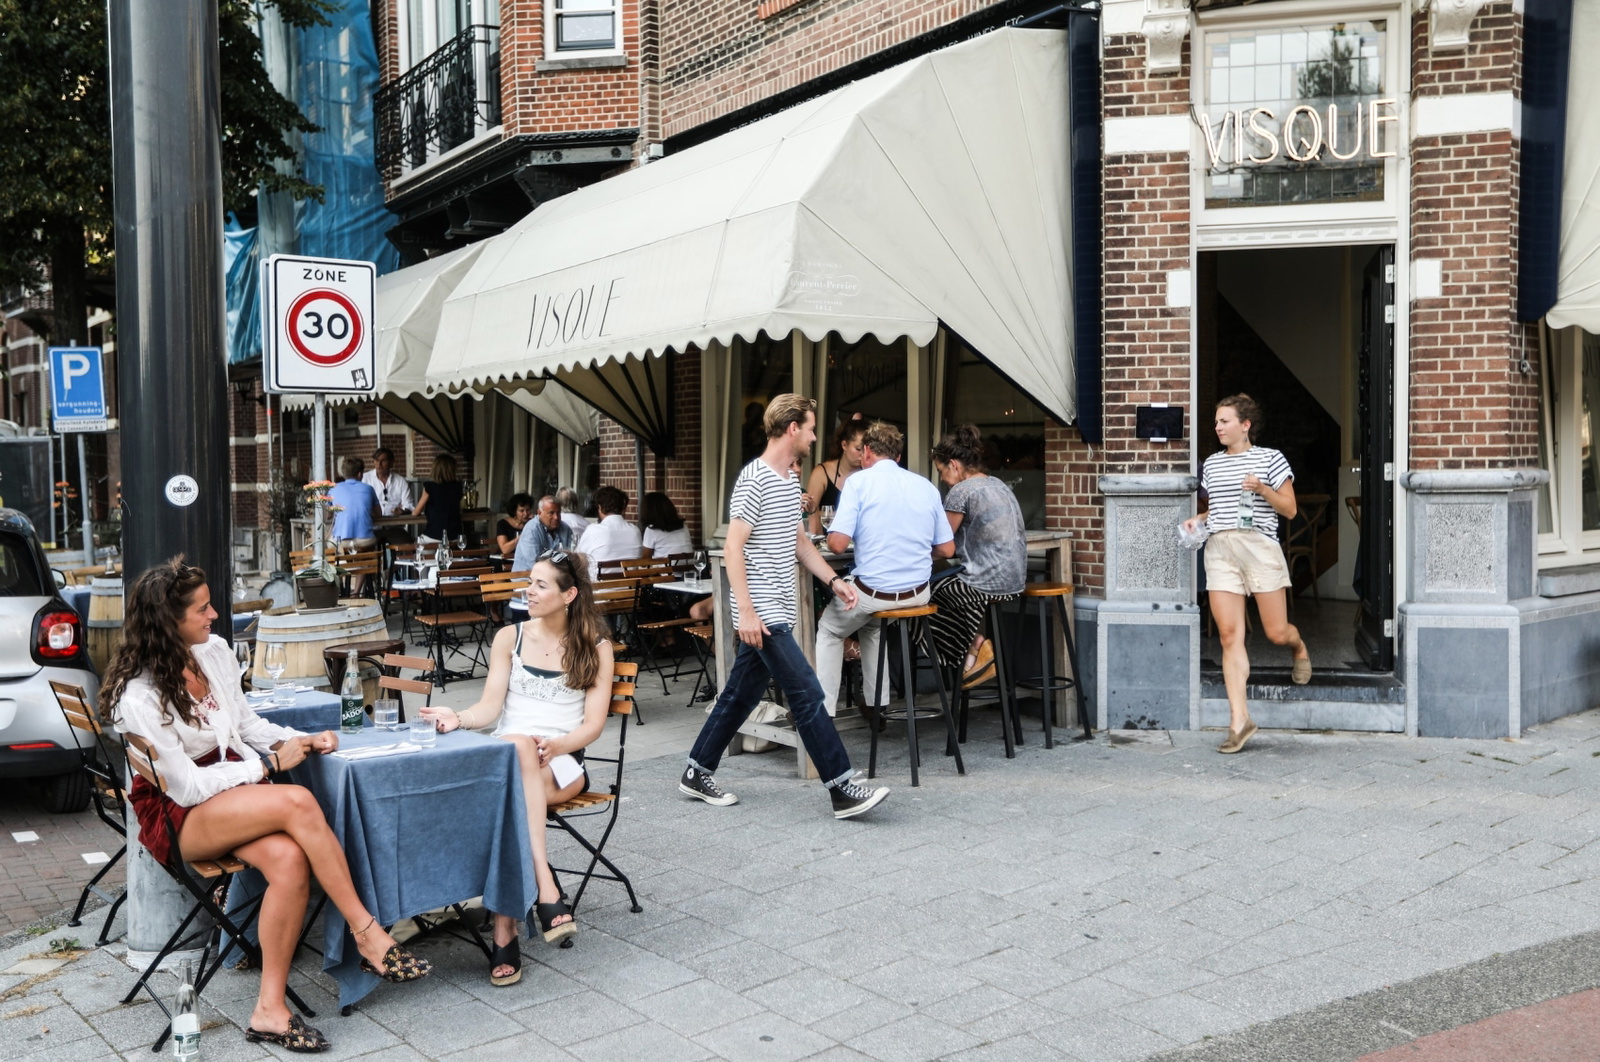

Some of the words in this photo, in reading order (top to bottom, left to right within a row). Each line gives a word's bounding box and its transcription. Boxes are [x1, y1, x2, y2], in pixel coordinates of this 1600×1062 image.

[1201, 98, 1399, 167] VISQUE
[303, 268, 347, 283] ZONE
[302, 311, 349, 340] 30
[526, 276, 625, 350] VISQUE
[62, 353, 91, 390] P
